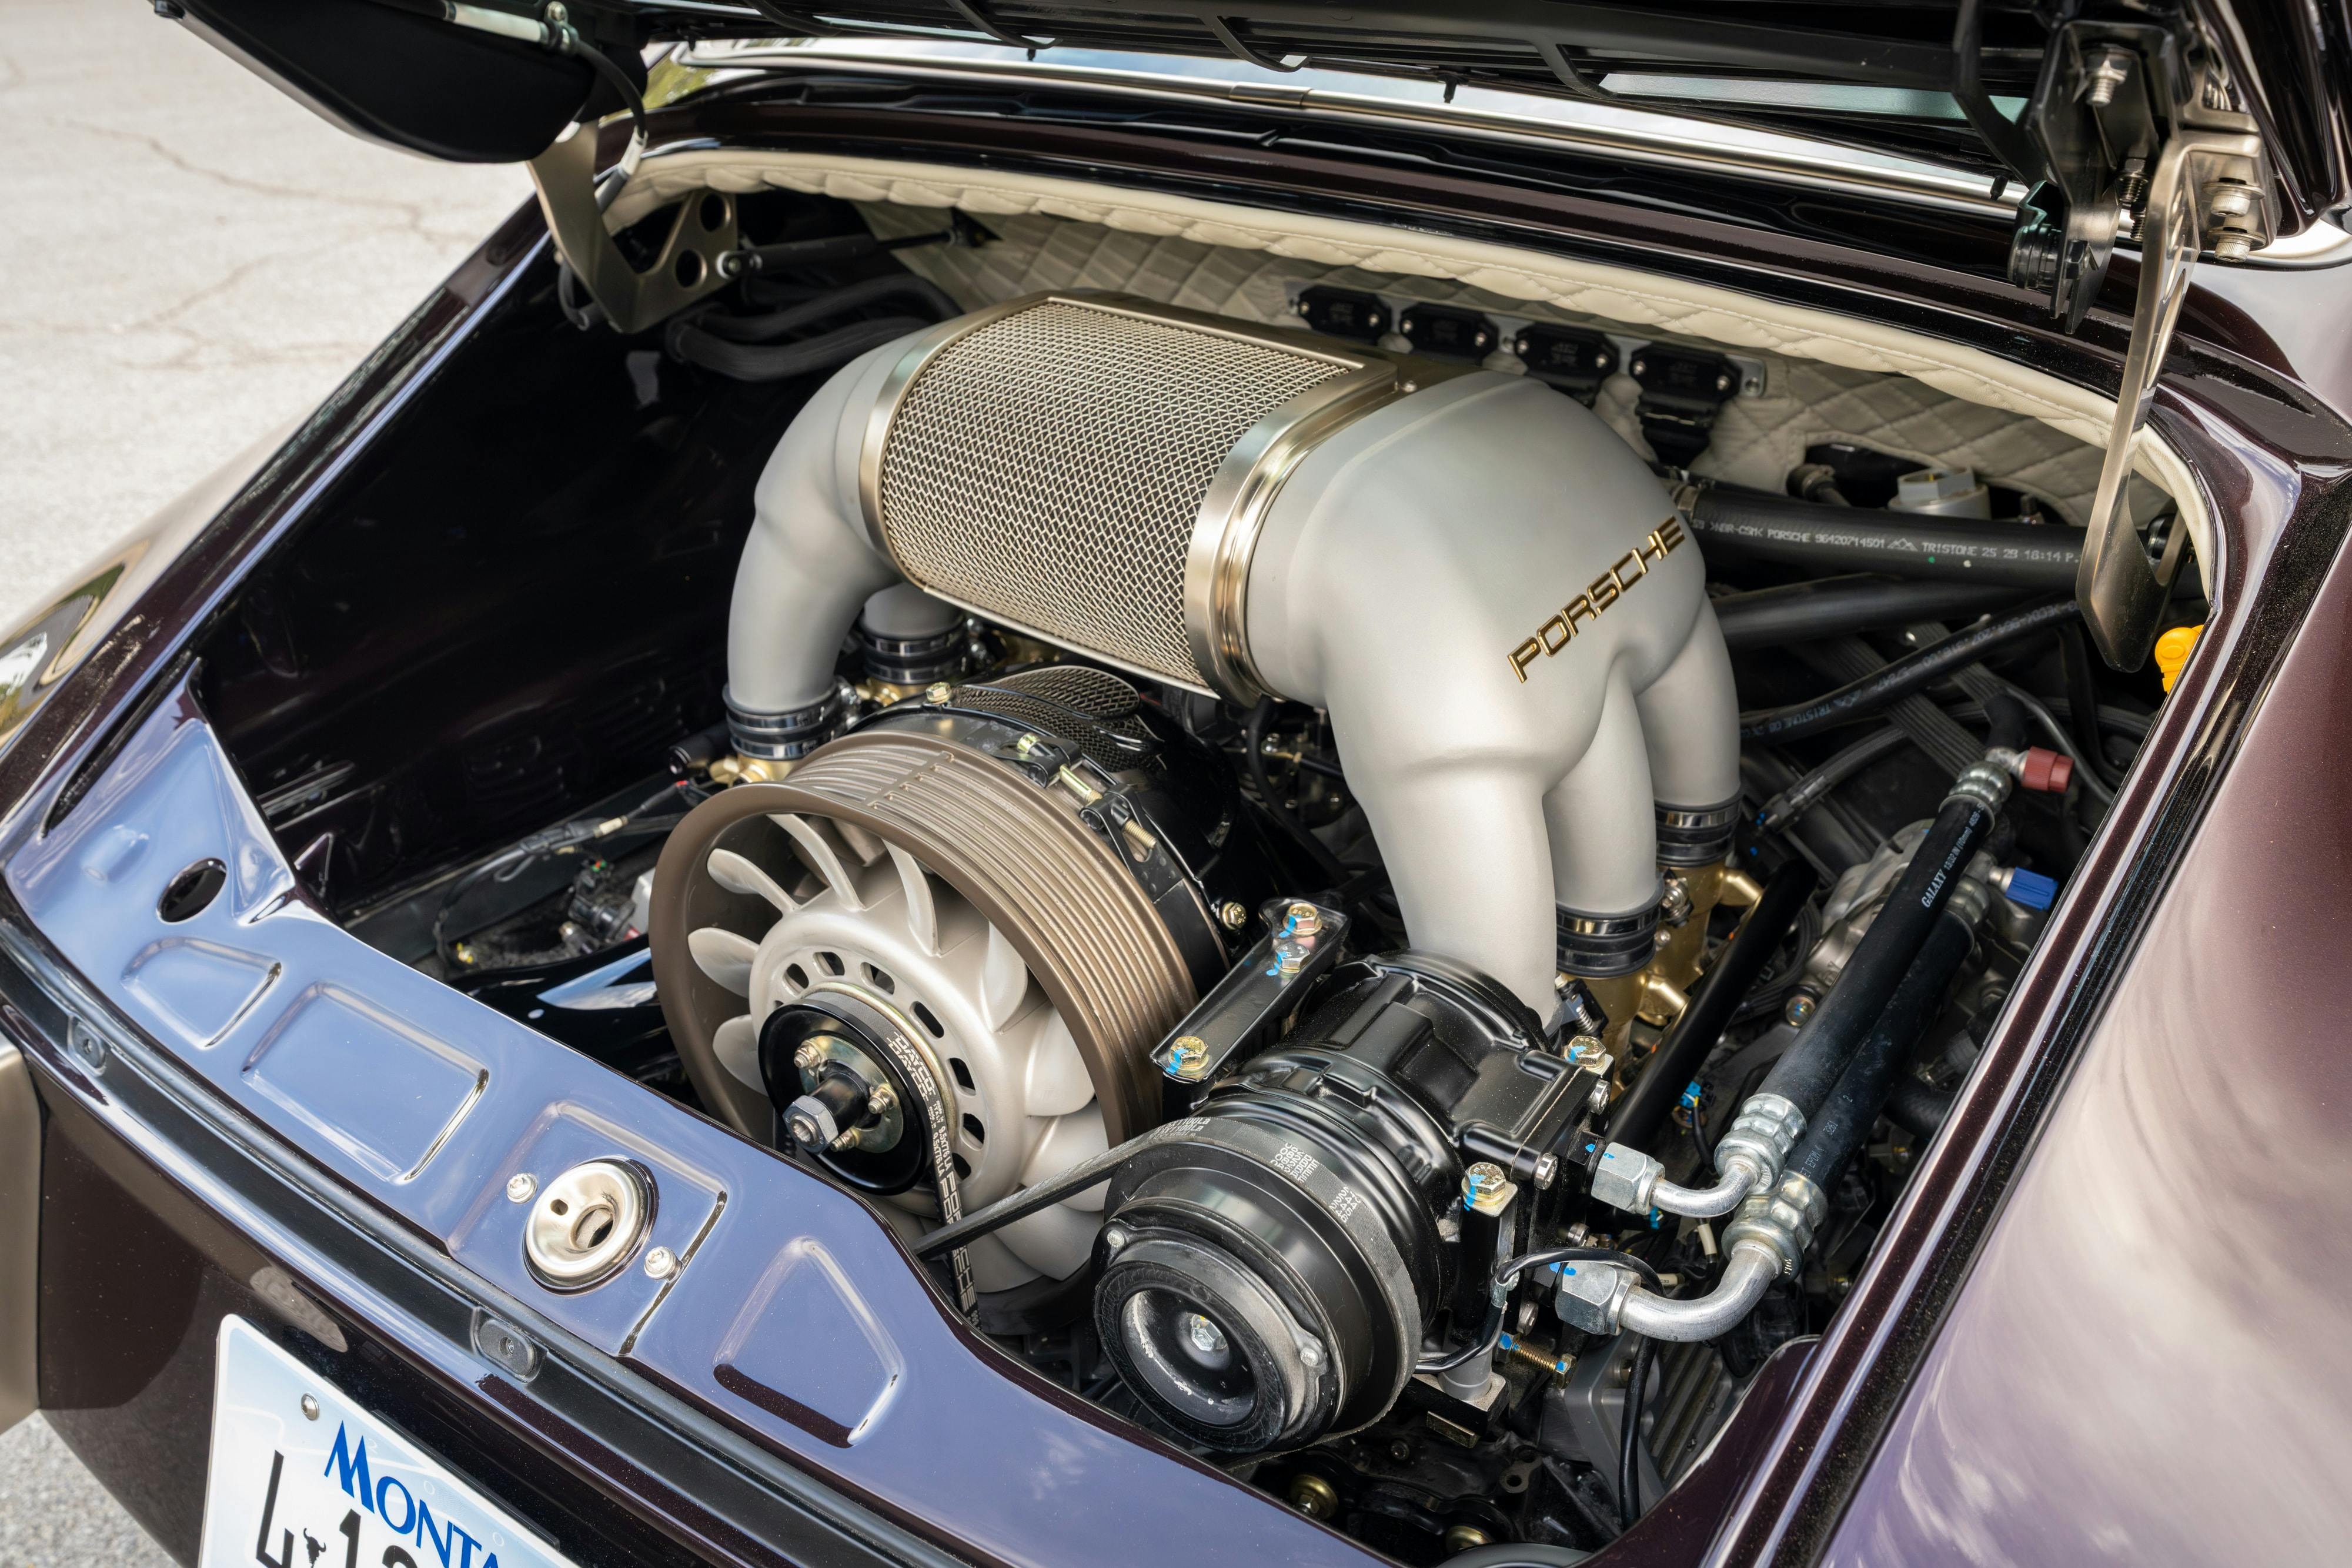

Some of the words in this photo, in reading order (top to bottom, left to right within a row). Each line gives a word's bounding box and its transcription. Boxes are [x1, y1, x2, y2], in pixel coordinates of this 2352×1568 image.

[1768, 529, 1810, 543] PORSCHE
[1922, 542, 1977, 557] TRISTONE
[1982, 547, 1997, 557] 25
[1507, 515, 1685, 683] PORSCHE
[1921, 868, 1947, 908] GALAXY
[889, 1040, 928, 1099] DAYCO
[895, 1033, 936, 1095] DAYCO
[1275, 1153, 1312, 1178] 082BE
[1280, 1147, 1317, 1172] 082BE
[1333, 1195, 1354, 1217] 245
[1338, 1188, 1359, 1210] 244
